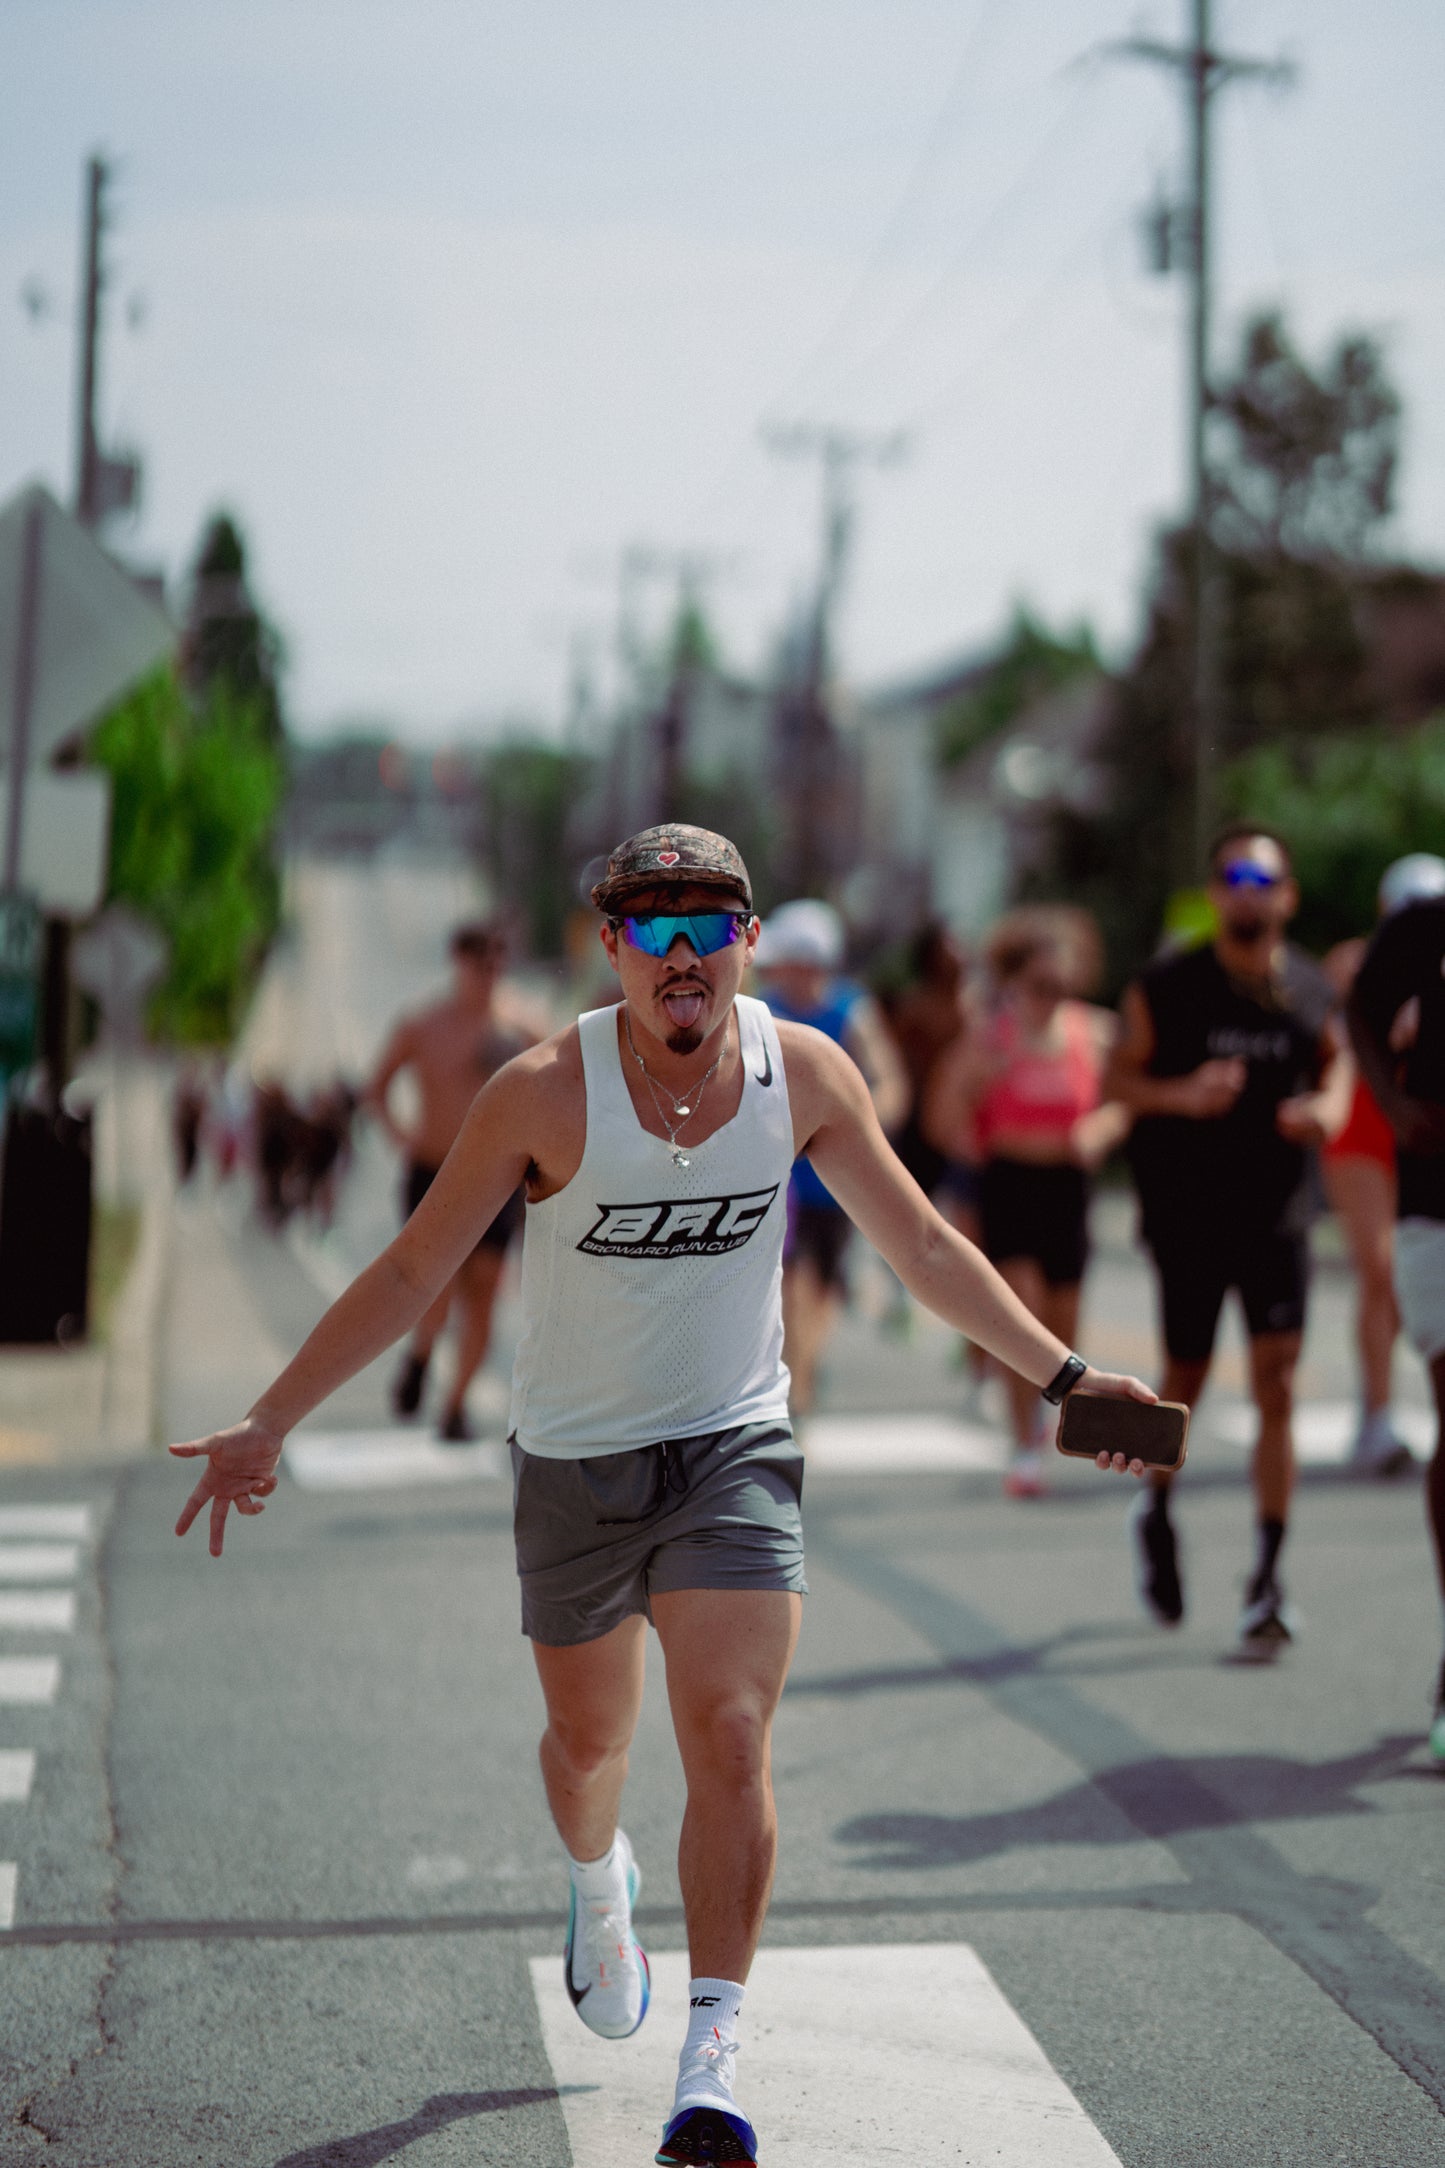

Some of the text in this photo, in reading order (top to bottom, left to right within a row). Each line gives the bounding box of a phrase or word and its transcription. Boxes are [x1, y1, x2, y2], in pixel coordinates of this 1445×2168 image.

[591, 1188, 778, 1243] BRC
[582, 1234, 749, 1255] BROWARD RUN CLUB
